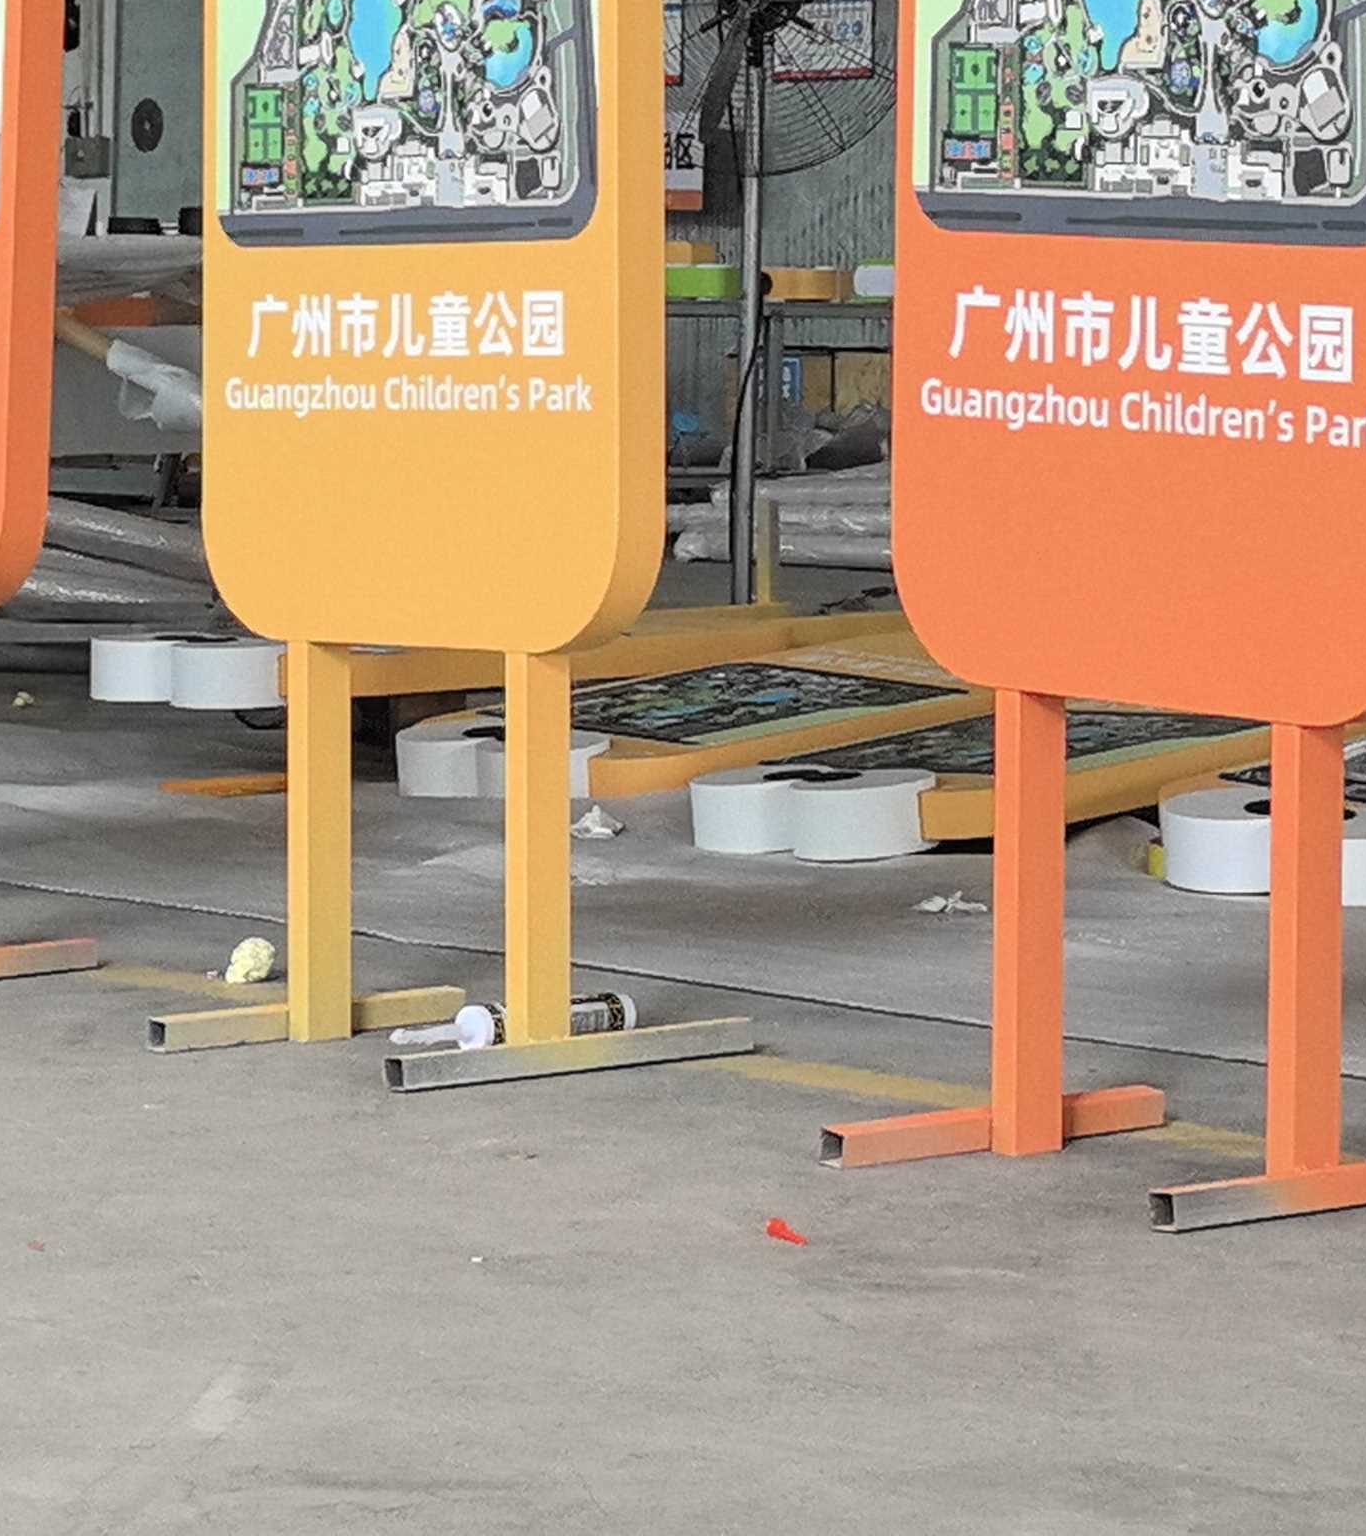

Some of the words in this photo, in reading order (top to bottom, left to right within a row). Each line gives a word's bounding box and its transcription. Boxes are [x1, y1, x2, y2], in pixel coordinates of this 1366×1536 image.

[248, 291, 564, 357] 广州市儿童公园
[950, 286, 1353, 382] 广州市儿童公园
[225, 376, 376, 418] Guangzhou
[384, 375, 520, 410] Children's
[529, 376, 592, 411] Park
[922, 378, 1109, 430] Guangzhou
[1121, 390, 1293, 442] Children's
